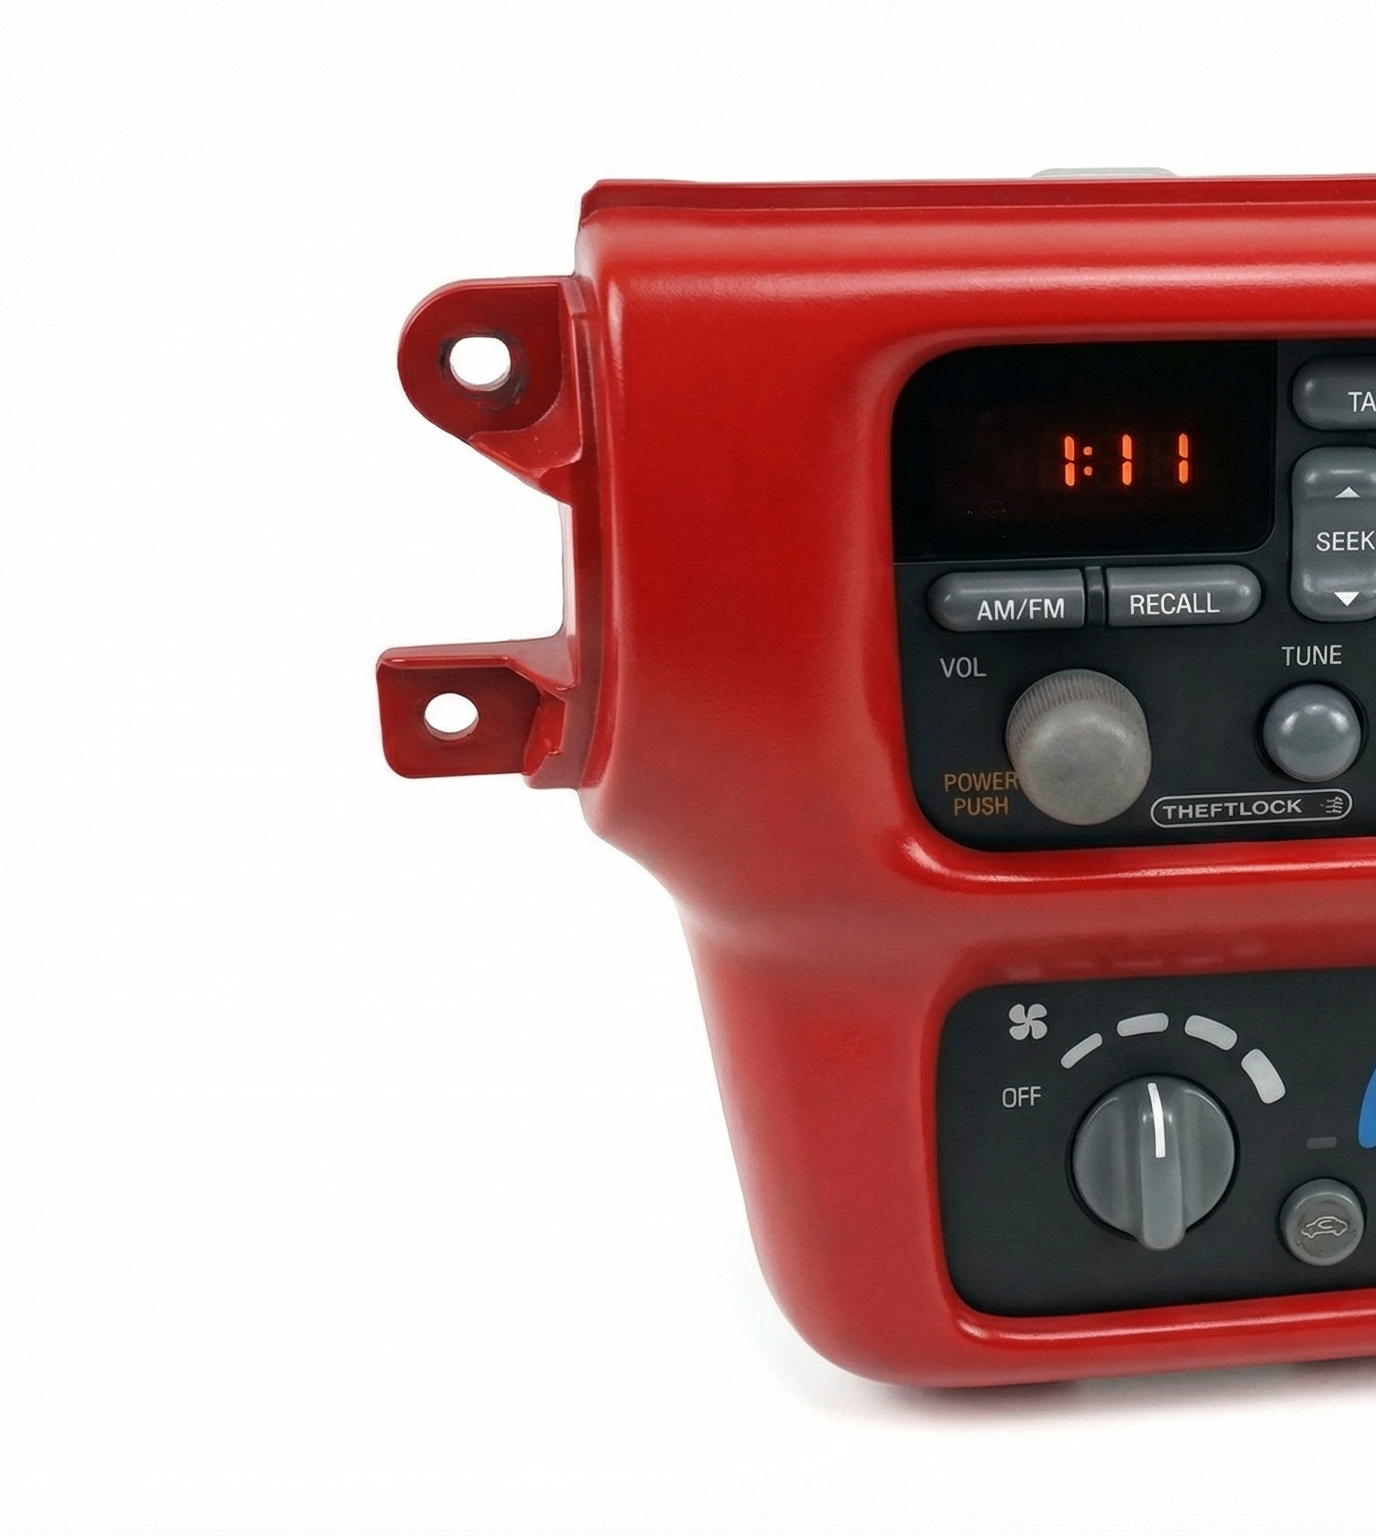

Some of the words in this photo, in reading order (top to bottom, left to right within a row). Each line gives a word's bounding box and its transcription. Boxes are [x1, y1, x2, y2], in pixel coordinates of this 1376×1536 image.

[1063, 433, 1189, 487] 1:11
[1316, 530, 1376, 552] SEEK
[976, 597, 1065, 622] AM/FM
[1129, 592, 1220, 616] RECALL
[1281, 644, 1343, 667] TUNE
[939, 656, 988, 679] VOL
[944, 771, 1019, 793] POWER
[954, 796, 1009, 817] PUSH
[1162, 799, 1303, 821] THEFTLOCK
[1002, 1085, 1042, 1109] OFF
